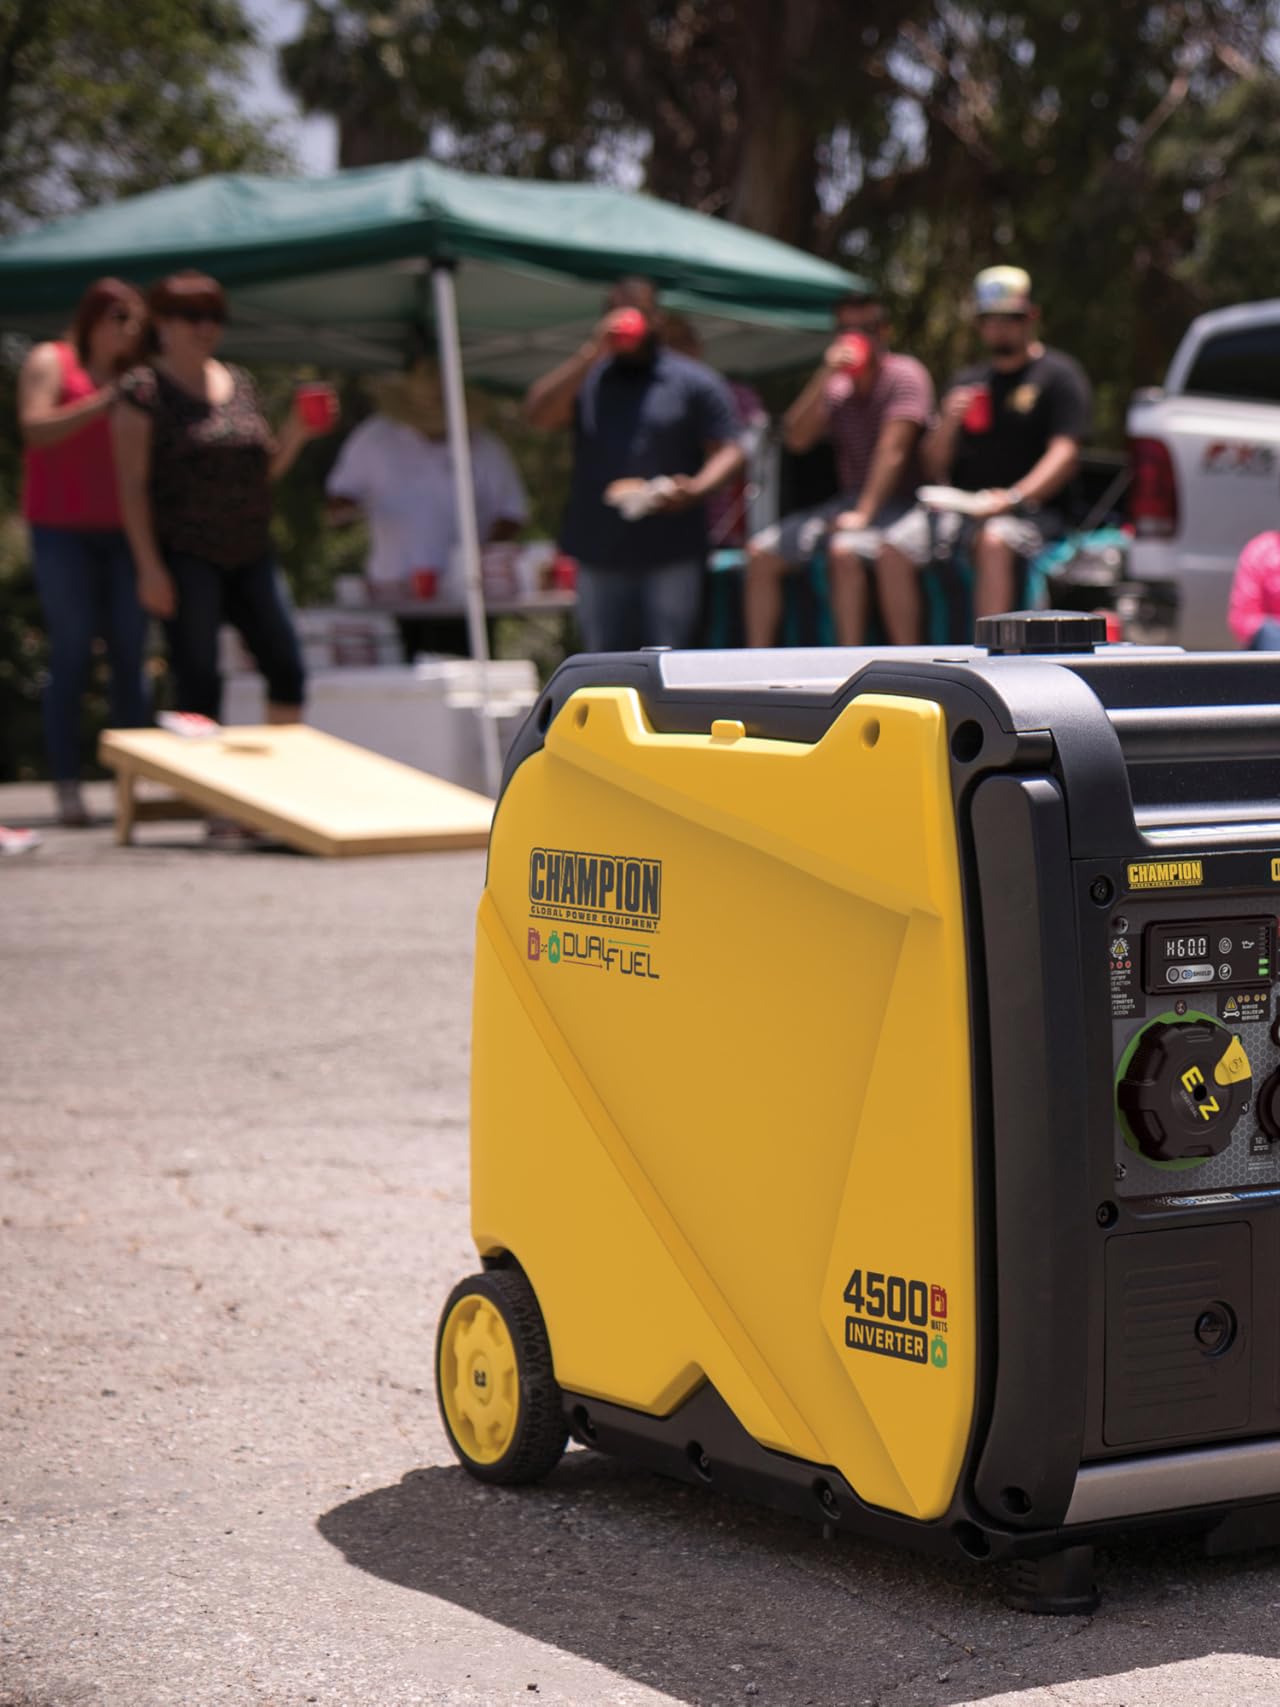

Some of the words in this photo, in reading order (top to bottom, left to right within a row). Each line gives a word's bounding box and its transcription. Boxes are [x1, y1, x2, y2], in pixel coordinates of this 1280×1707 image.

[530, 850, 660, 915] CHAMPION
[1128, 861, 1202, 883] CHAMPION
[530, 905, 563, 918] GLOBAL
[566, 909, 598, 921] POWER
[601, 914, 659, 930] EQUIPMENT
[842, 1268, 929, 1327] 4500
[848, 1321, 925, 1358] INVERTER
